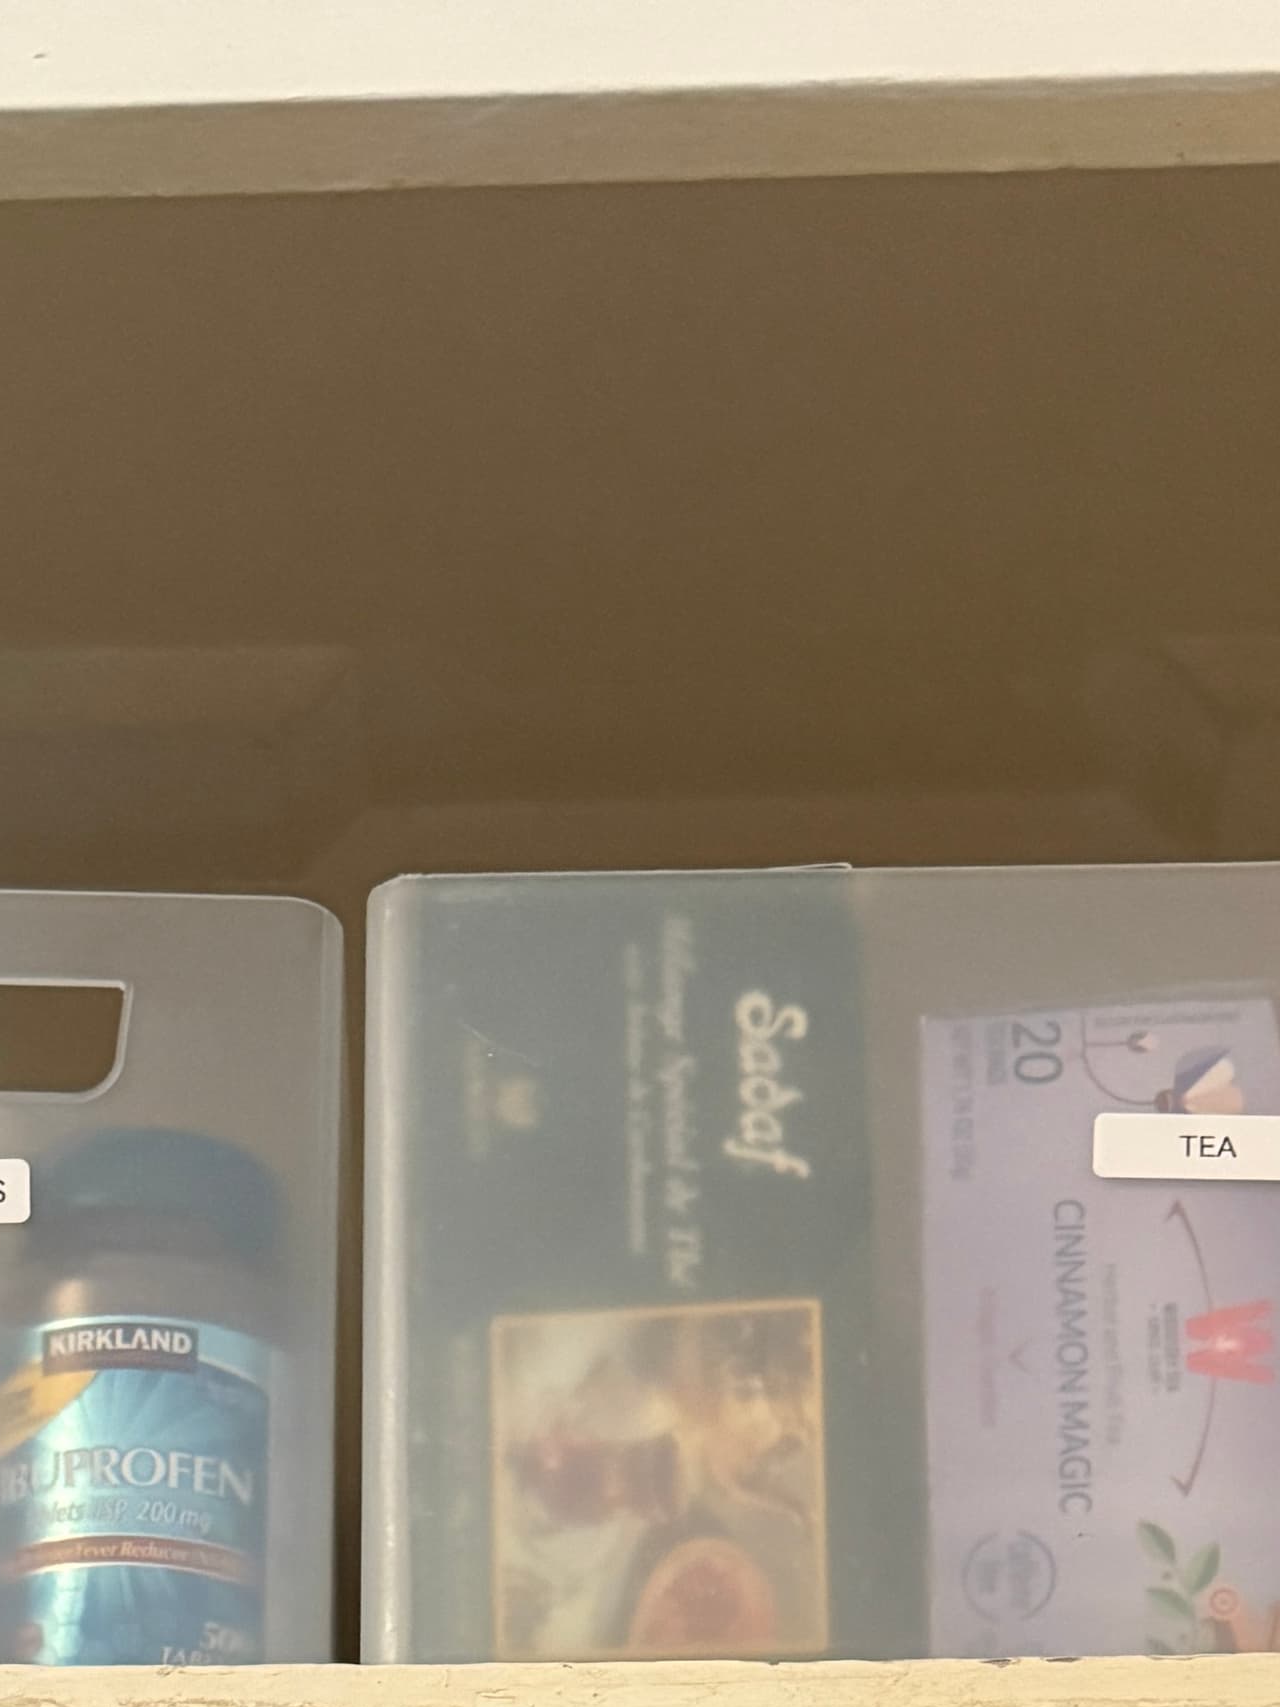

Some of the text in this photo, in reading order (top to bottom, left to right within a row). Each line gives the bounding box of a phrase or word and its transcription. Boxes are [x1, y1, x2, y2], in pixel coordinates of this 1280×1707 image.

[1012, 1020, 1064, 1086] 20
[723, 988, 811, 1179] Sadaf
[1180, 1133, 1238, 1159] TEA
[48, 1327, 193, 1356] KIRKLAND
[1053, 1199, 1093, 1515] CINNAMON MAGIC
[0, 1446, 255, 1506] IBUPROFEN
[135, 1499, 176, 1523] 200
